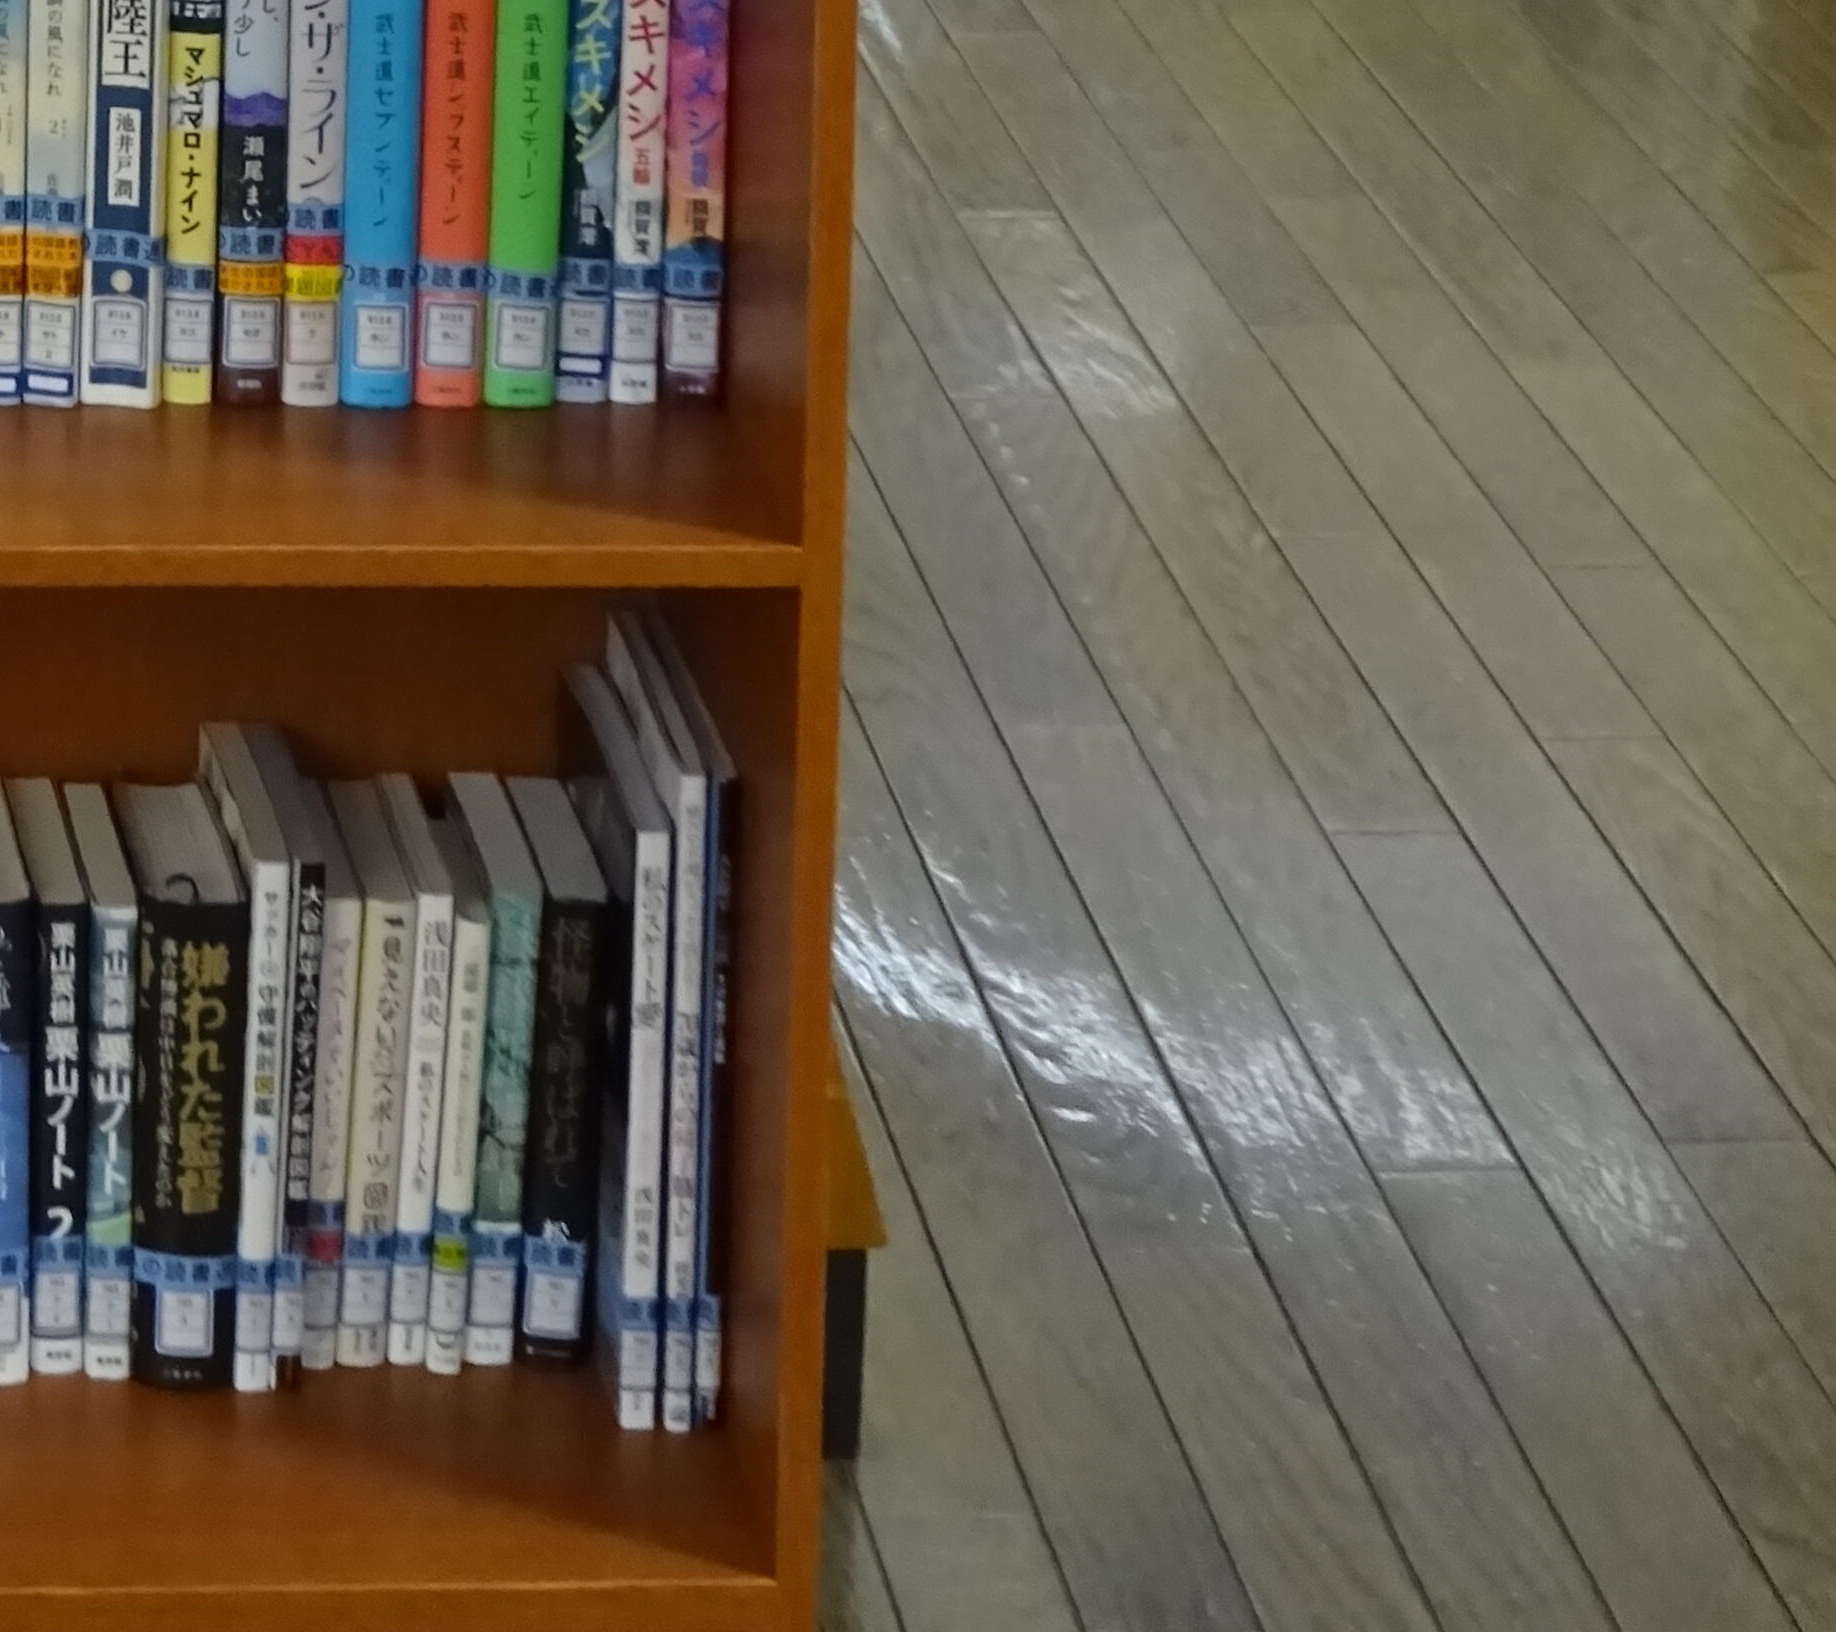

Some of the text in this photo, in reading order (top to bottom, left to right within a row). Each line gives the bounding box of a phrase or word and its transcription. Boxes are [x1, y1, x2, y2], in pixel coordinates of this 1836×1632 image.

[48, 121, 60, 135] 2
[179, 45, 207, 235] マシュマロ・ナイン
[518, 11, 544, 201] 武士道エイティーン
[113, 111, 137, 204] 池井戸潤
[240, 133, 266, 226] 瀬尾まい
